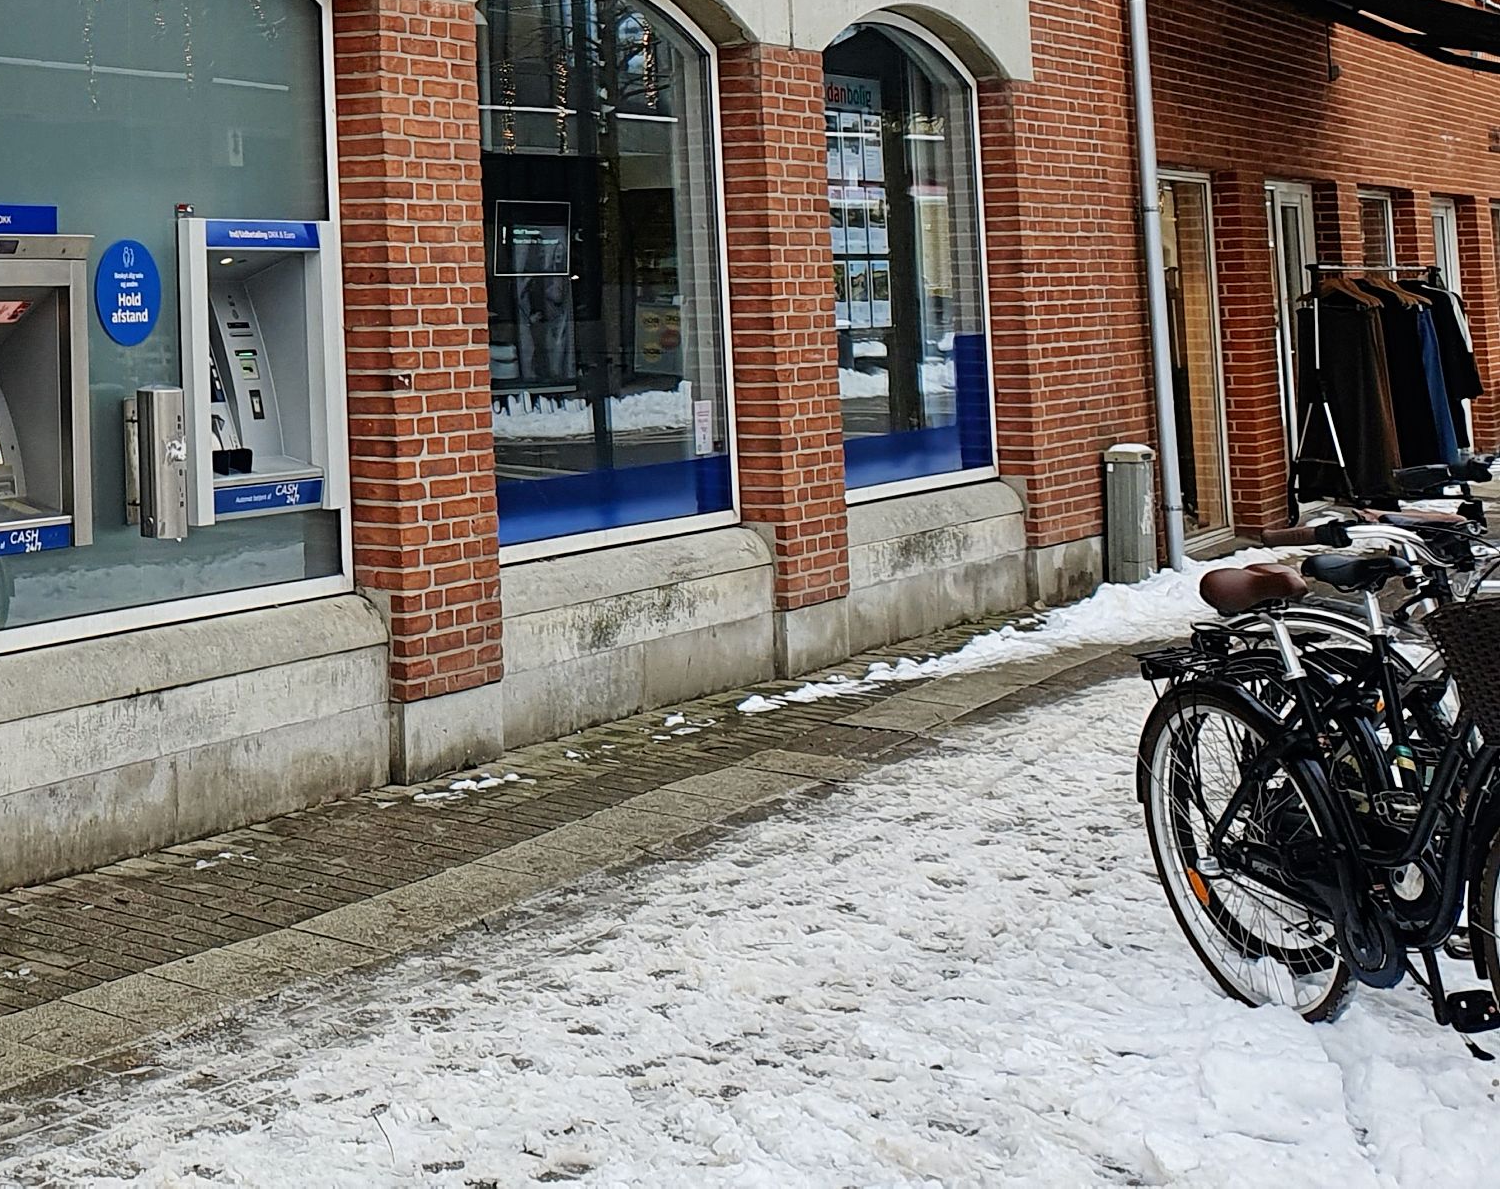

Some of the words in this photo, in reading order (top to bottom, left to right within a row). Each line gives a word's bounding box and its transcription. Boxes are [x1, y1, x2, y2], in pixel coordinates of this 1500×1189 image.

[826, 81, 872, 109] danbolig
[117, 292, 142, 307] Hold
[111, 308, 149, 323] afstand
[275, 483, 299, 496] CASH
[10, 529, 39, 545] CASH
[25, 541, 42, 553] 24/7
